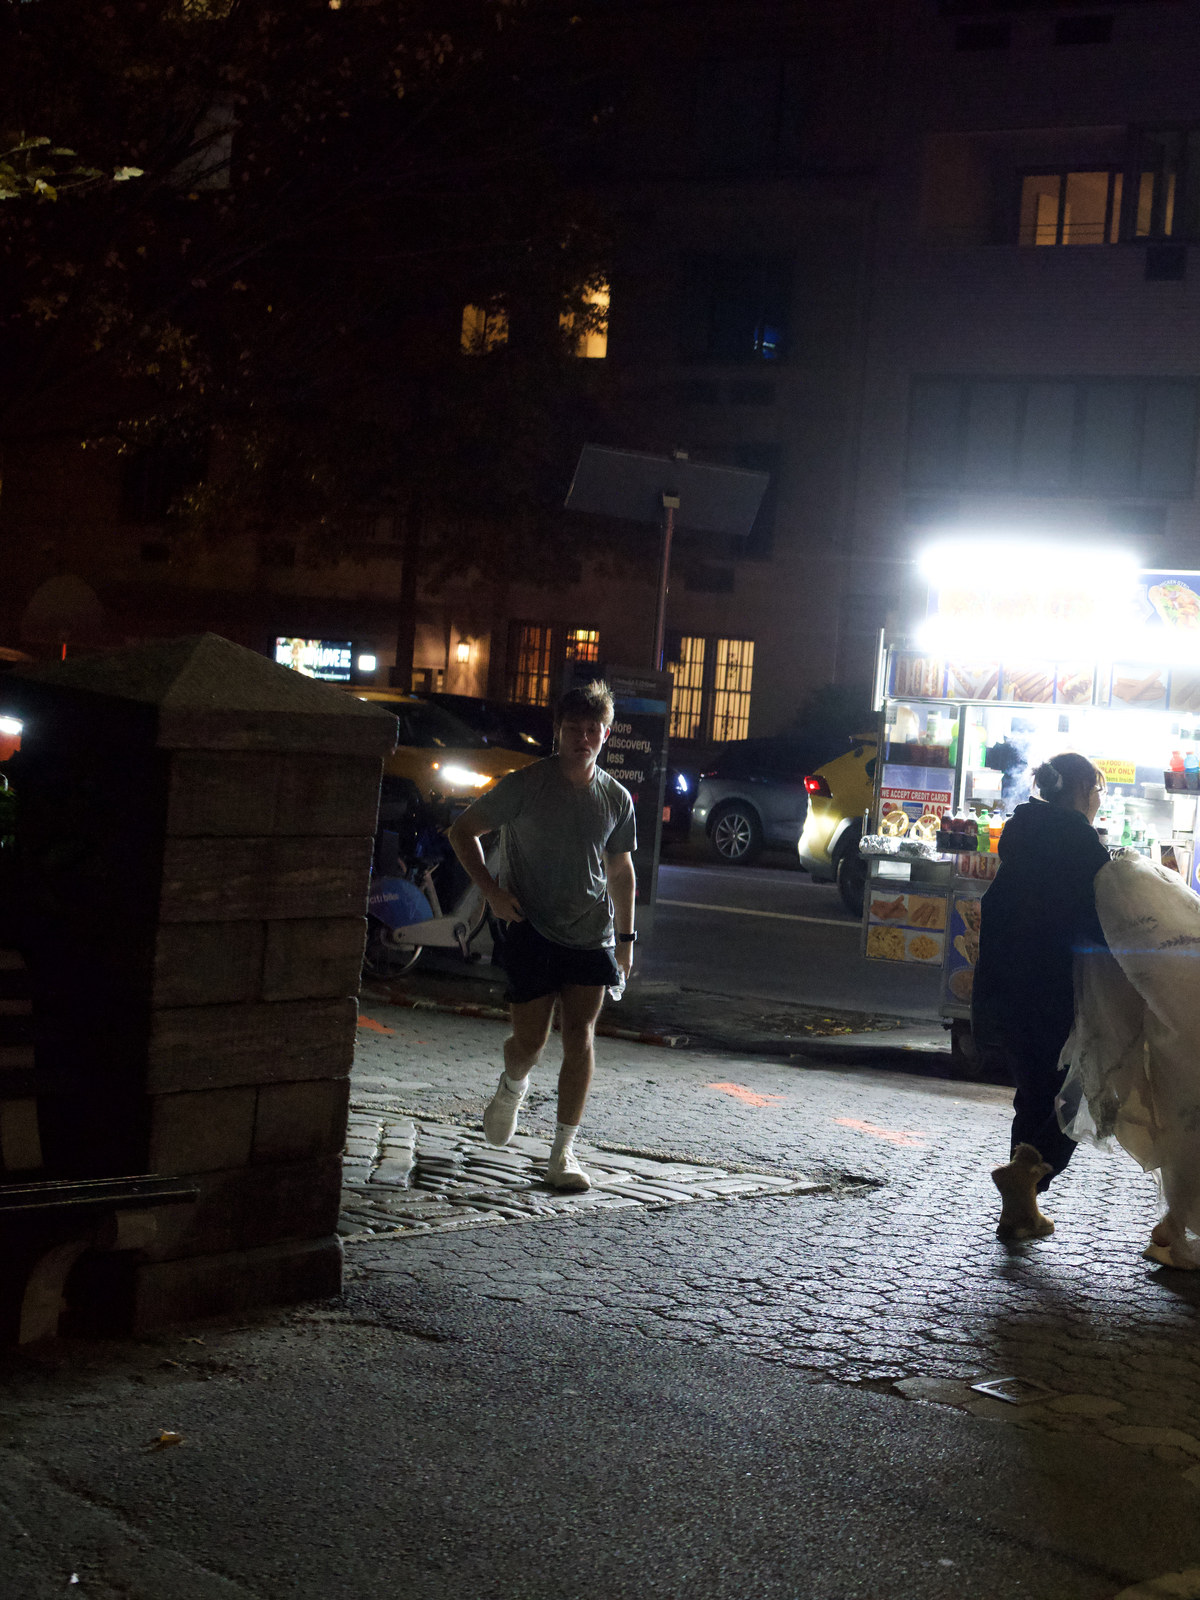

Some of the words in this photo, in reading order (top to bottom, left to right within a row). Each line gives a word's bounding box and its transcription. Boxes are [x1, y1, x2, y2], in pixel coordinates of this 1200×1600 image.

[608, 738, 652, 753] discovery,
[606, 751, 625, 764] less
[881, 789, 890, 798] WE
[890, 790, 911, 799] ACCEPT
[911, 791, 930, 800] CREDIT
[931, 793, 949, 802] CARDS
